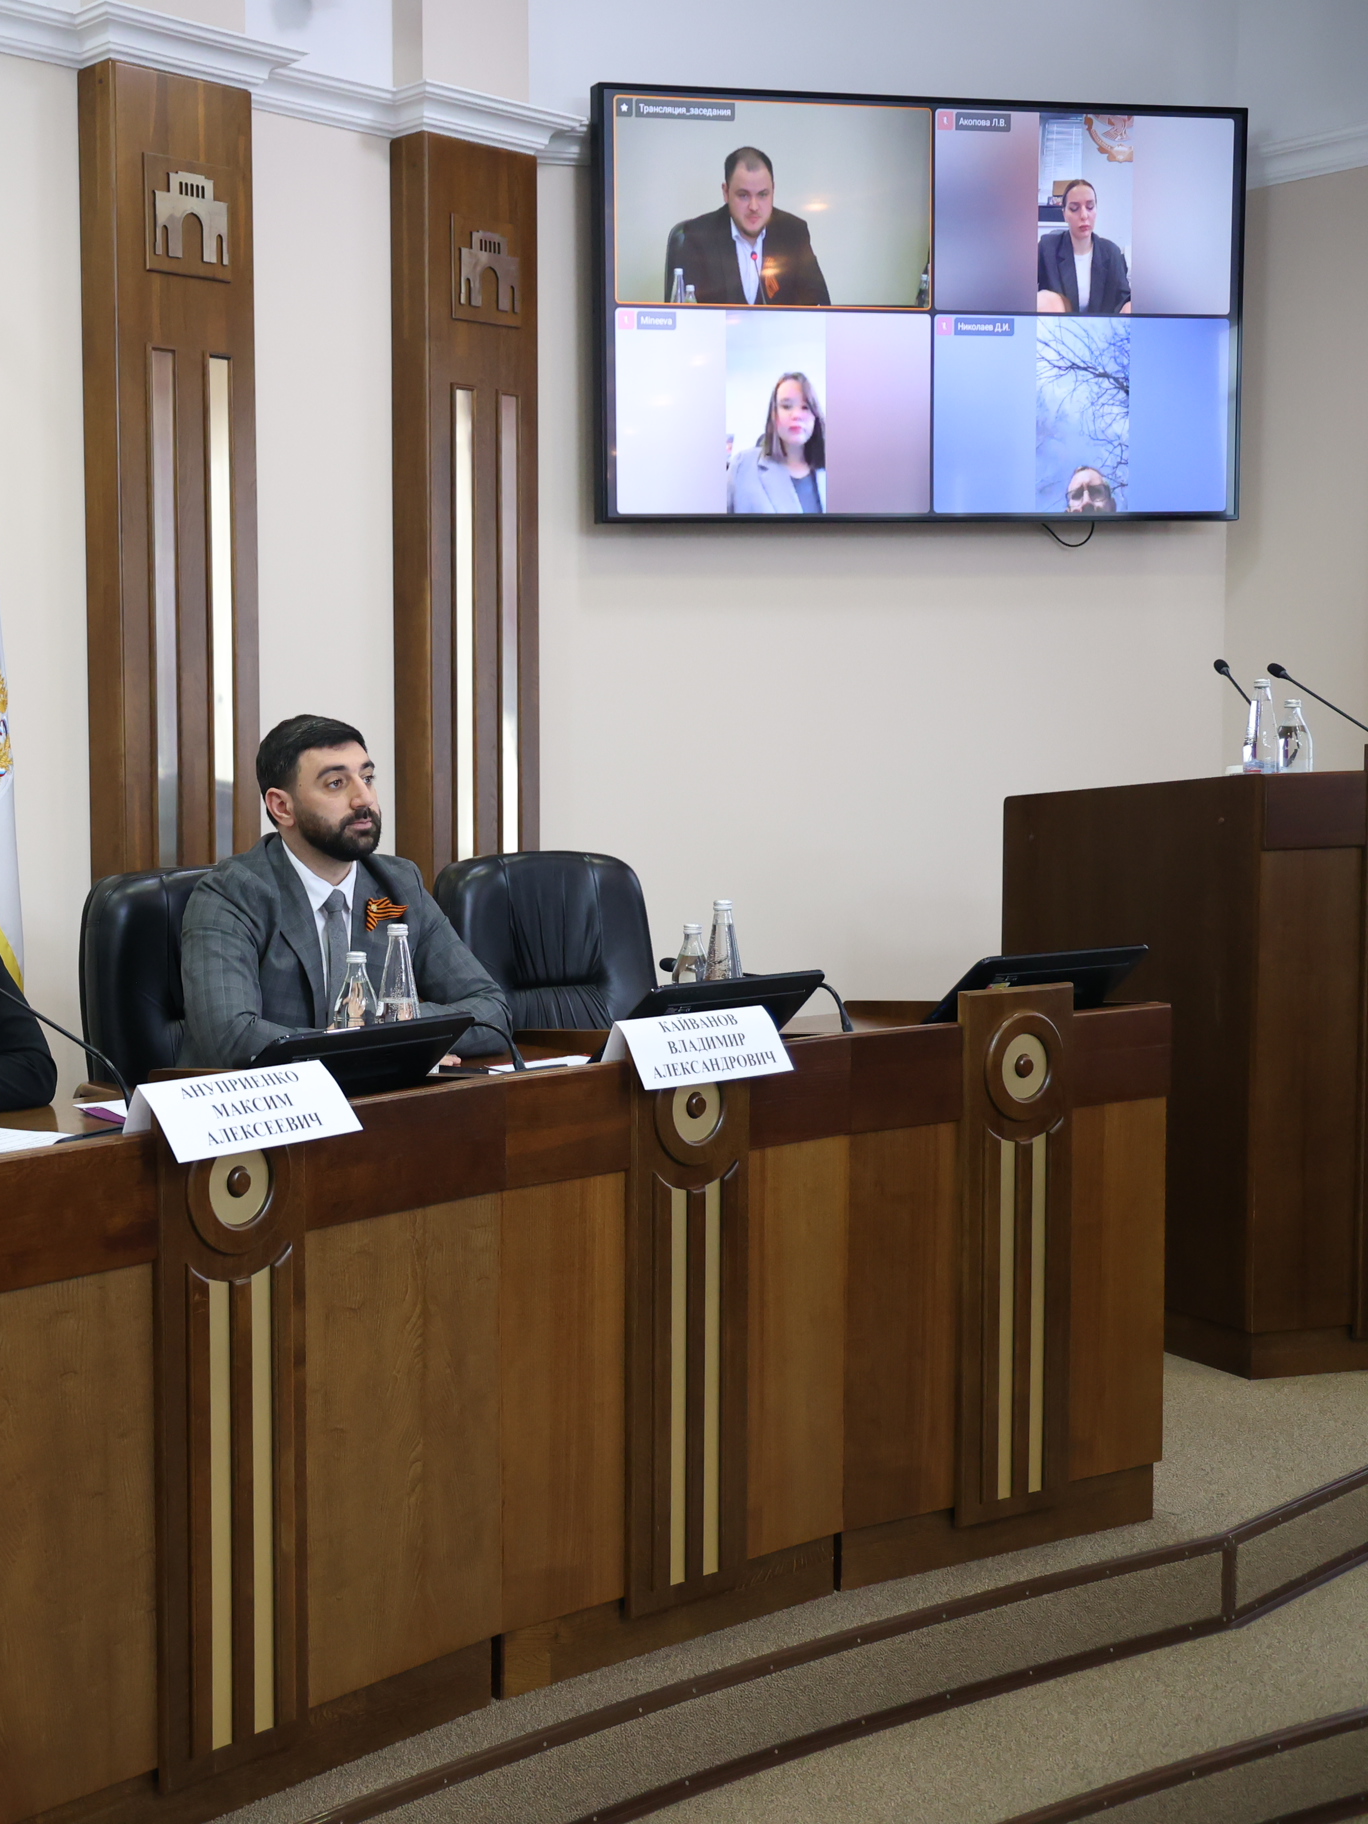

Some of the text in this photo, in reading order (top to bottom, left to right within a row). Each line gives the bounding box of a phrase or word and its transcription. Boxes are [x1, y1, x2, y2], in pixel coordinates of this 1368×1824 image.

[639, 103, 731, 116] Трансляция_заседания
[958, 117, 1007, 127] Акопова Л.В.
[640, 315, 673, 325] Mineeva
[957, 322, 1011, 333] Николаев Д.И.
[658, 1013, 738, 1034] КАЙВАНОВ
[667, 1032, 746, 1055] ВЛАДИМИР
[653, 1051, 777, 1079] АЛЕКСАНДРОВИЧ
[180, 1070, 300, 1100] АНУПРИЕНКО
[211, 1093, 294, 1120] МАКСИМ
[207, 1112, 324, 1147] АЛЕКСЕЕВИЧ
